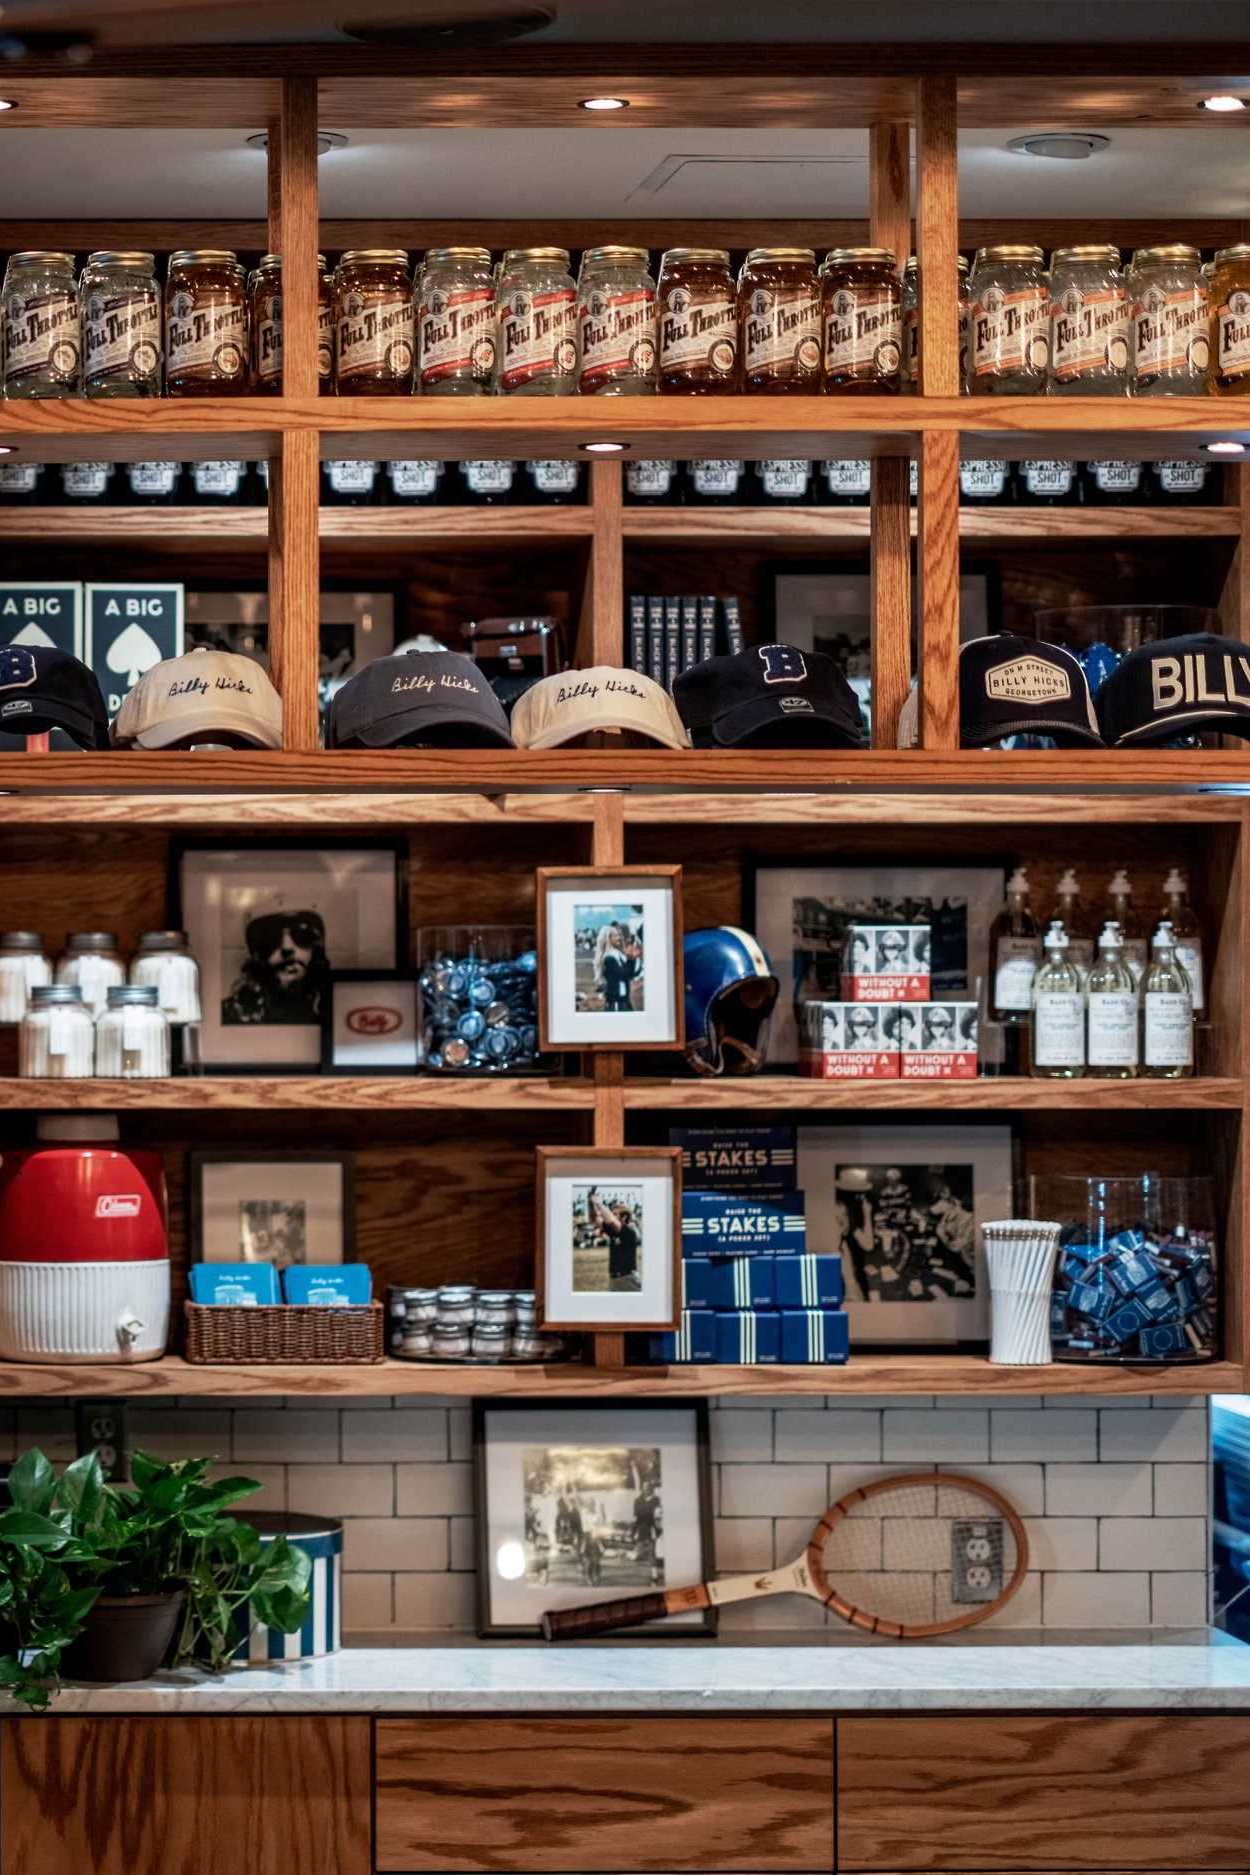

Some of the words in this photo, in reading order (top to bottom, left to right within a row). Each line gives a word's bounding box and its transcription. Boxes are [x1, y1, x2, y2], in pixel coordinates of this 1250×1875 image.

[169, 323, 192, 356] FULL
[262, 326, 282, 360] FUL
[340, 323, 364, 356] FULL
[423, 320, 448, 354] FULL
[583, 321, 608, 356] FULL
[663, 318, 688, 351] FULL
[748, 320, 772, 355] FULL
[828, 320, 853, 354] FULL
[1057, 318, 1084, 353] FULL
[1138, 318, 1166, 352] FULL
[774, 473, 799, 485] SHOT
[970, 472, 994, 484] SHOT
[1037, 471, 1062, 483] SHOT
[1107, 469, 1131, 481] SHOT
[1170, 469, 1195, 482] SHOT
[3, 598, 18, 615] A
[24, 597, 61, 615] BIG
[105, 599, 121, 616] A
[126, 598, 163, 616] BIG
[759, 644, 808, 684] B
[1004, 666, 1014, 675] ON
[1026, 664, 1053, 675] STREET
[169, 677, 209, 697] Billy
[216, 677, 253, 695] Hicks
[391, 677, 435, 694] Billy
[441, 675, 479, 694] Hicks
[993, 676, 1027, 687] BILLY
[1034, 676, 1065, 687] HICKS
[557, 682, 599, 703] Billy
[606, 680, 647, 699] Hicks
[1005, 688, 1057, 696] GEORGETOWN
[858, 977, 908, 988] WITHOUT
[910, 977, 920, 987] A
[858, 988, 895, 999] DOUBT
[826, 1054, 877, 1065] WITHOUT
[880, 1054, 889, 1064] A
[904, 1054, 954, 1065] WITHOUT
[957, 1054, 967, 1064] A
[826, 1065, 863, 1076] DOUBT
[904, 1065, 941, 1076] DOUBT
[695, 1150, 767, 1167] STAKES
[707, 1216, 780, 1233] STAKES
